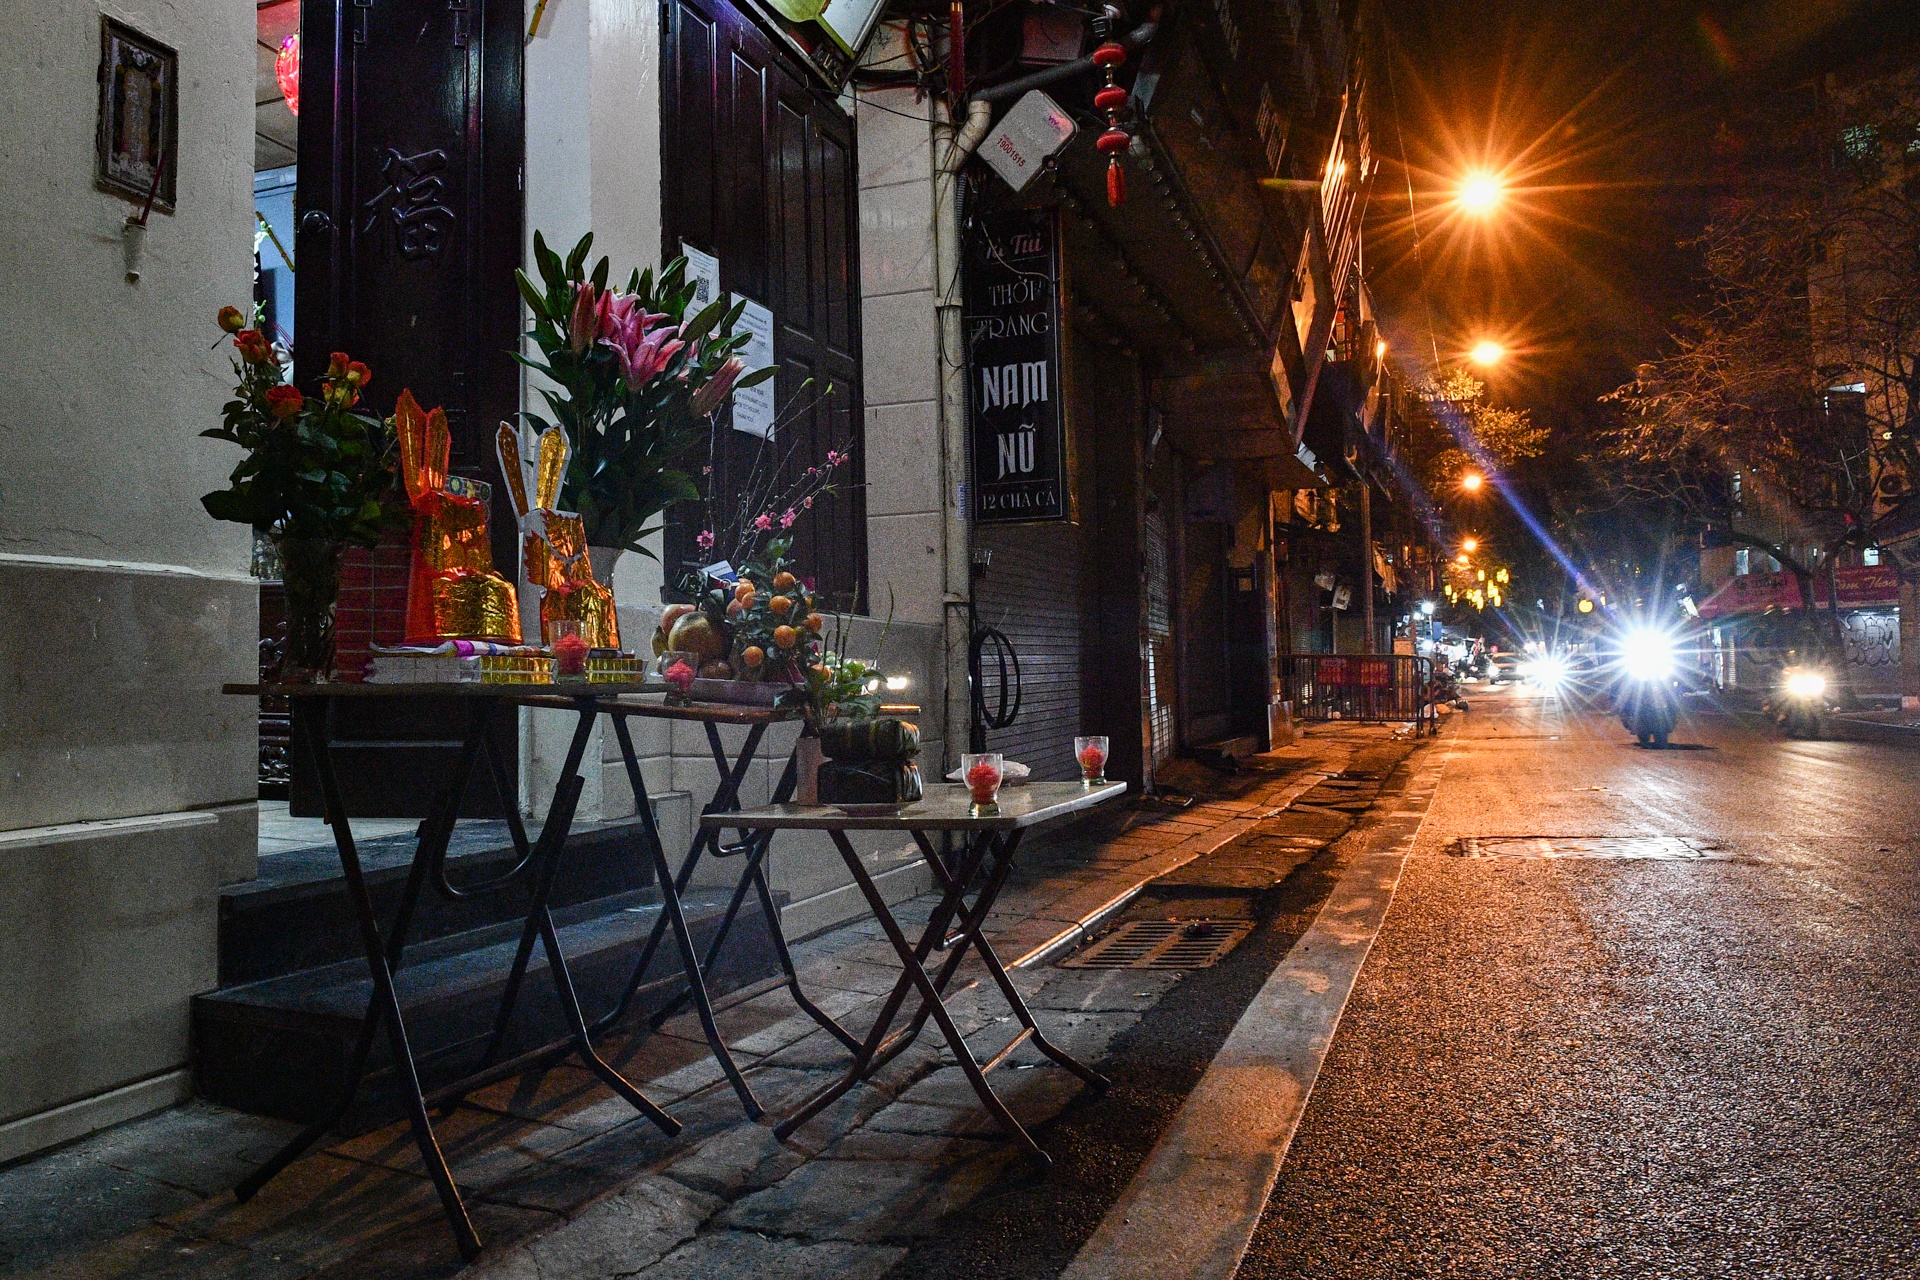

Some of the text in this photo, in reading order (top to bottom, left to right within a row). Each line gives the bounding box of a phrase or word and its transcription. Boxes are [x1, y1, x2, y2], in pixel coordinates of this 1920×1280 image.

[996, 138, 1026, 167] 19001515
[981, 360, 1049, 414] NAM
[997, 422, 1037, 480] NỮ
[982, 493, 996, 510] 12
